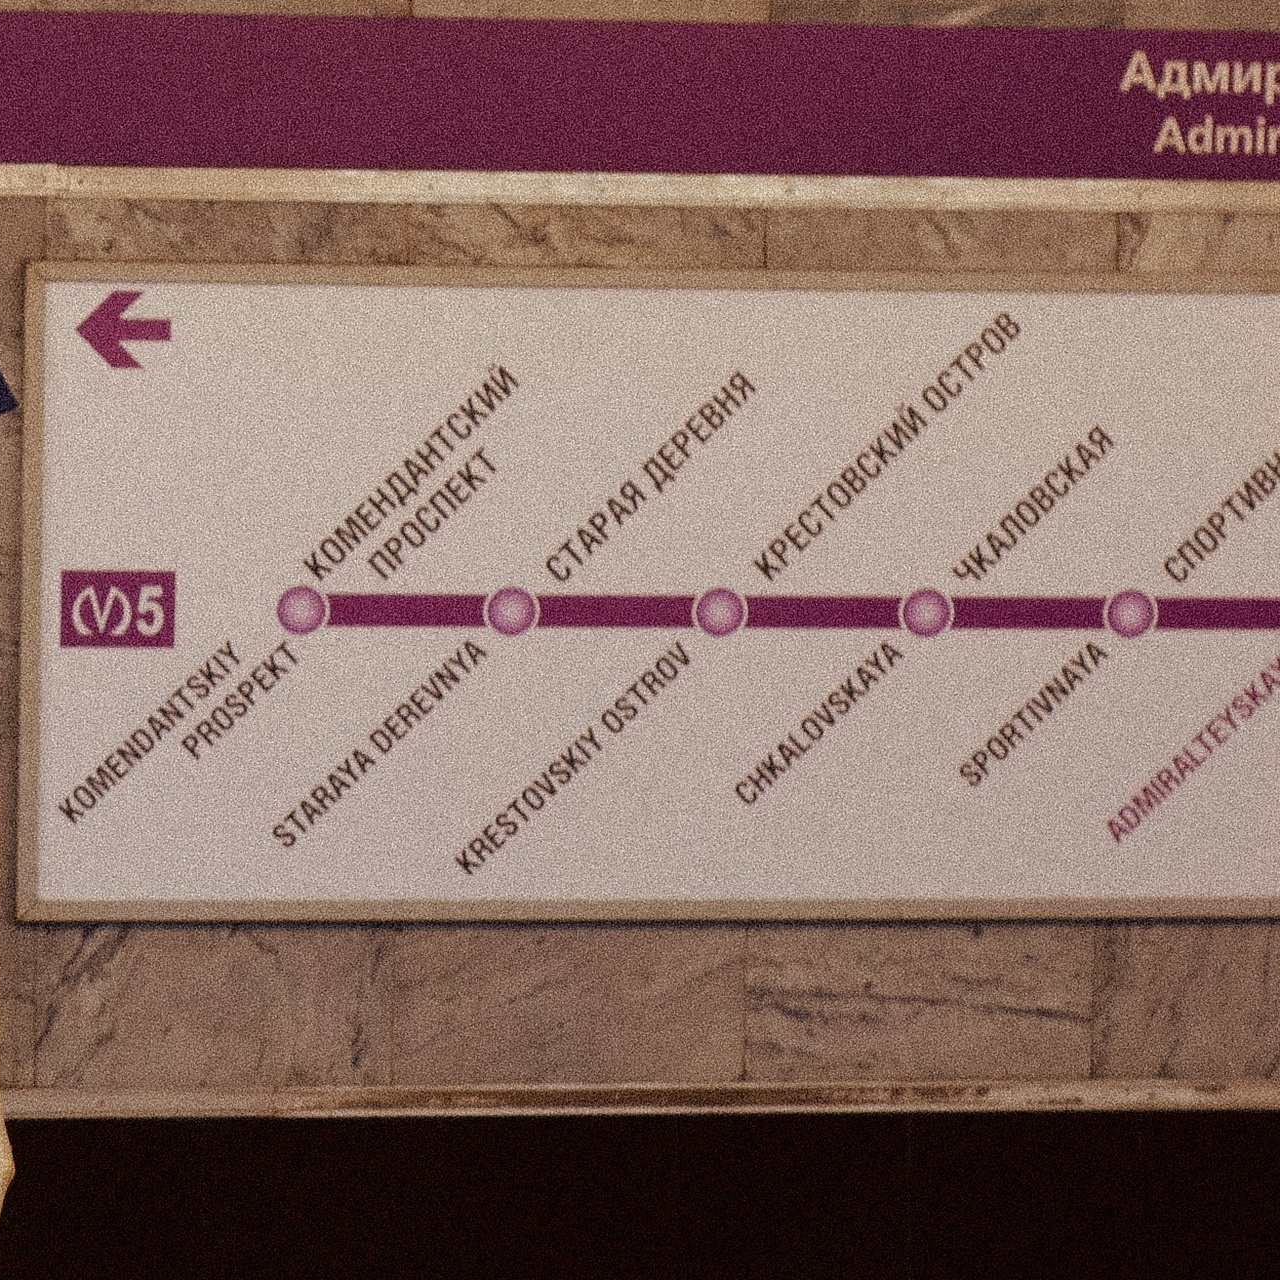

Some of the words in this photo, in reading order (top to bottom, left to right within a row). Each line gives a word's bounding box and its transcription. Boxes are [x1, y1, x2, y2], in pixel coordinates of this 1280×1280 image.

[303, 363, 518, 580] КОМЕНДАНТСКИЙ
[368, 448, 496, 580] ПРОСПЕКТ
[546, 477, 648, 582] СТАРАЯ
[642, 372, 755, 493] ДЕРЕВНЯ
[753, 402, 927, 581] КРЕСТОВСКИЙ
[922, 313, 1020, 413] ОСТРОВ
[952, 426, 1114, 580] ЧКАЛОВСКАЯ
[58, 641, 240, 824] KOMENDANTSKIY
[181, 642, 297, 759] PROSPEKT
[272, 749, 375, 848] STARAYA
[369, 641, 487, 753] DEREVNYA
[455, 725, 604, 875] KRESTOVSKIY
[601, 642, 690, 734] OSTROV
[734, 639, 903, 805] CHKALOVSKAYA
[959, 640, 1108, 787] SPORTIVNAYA
